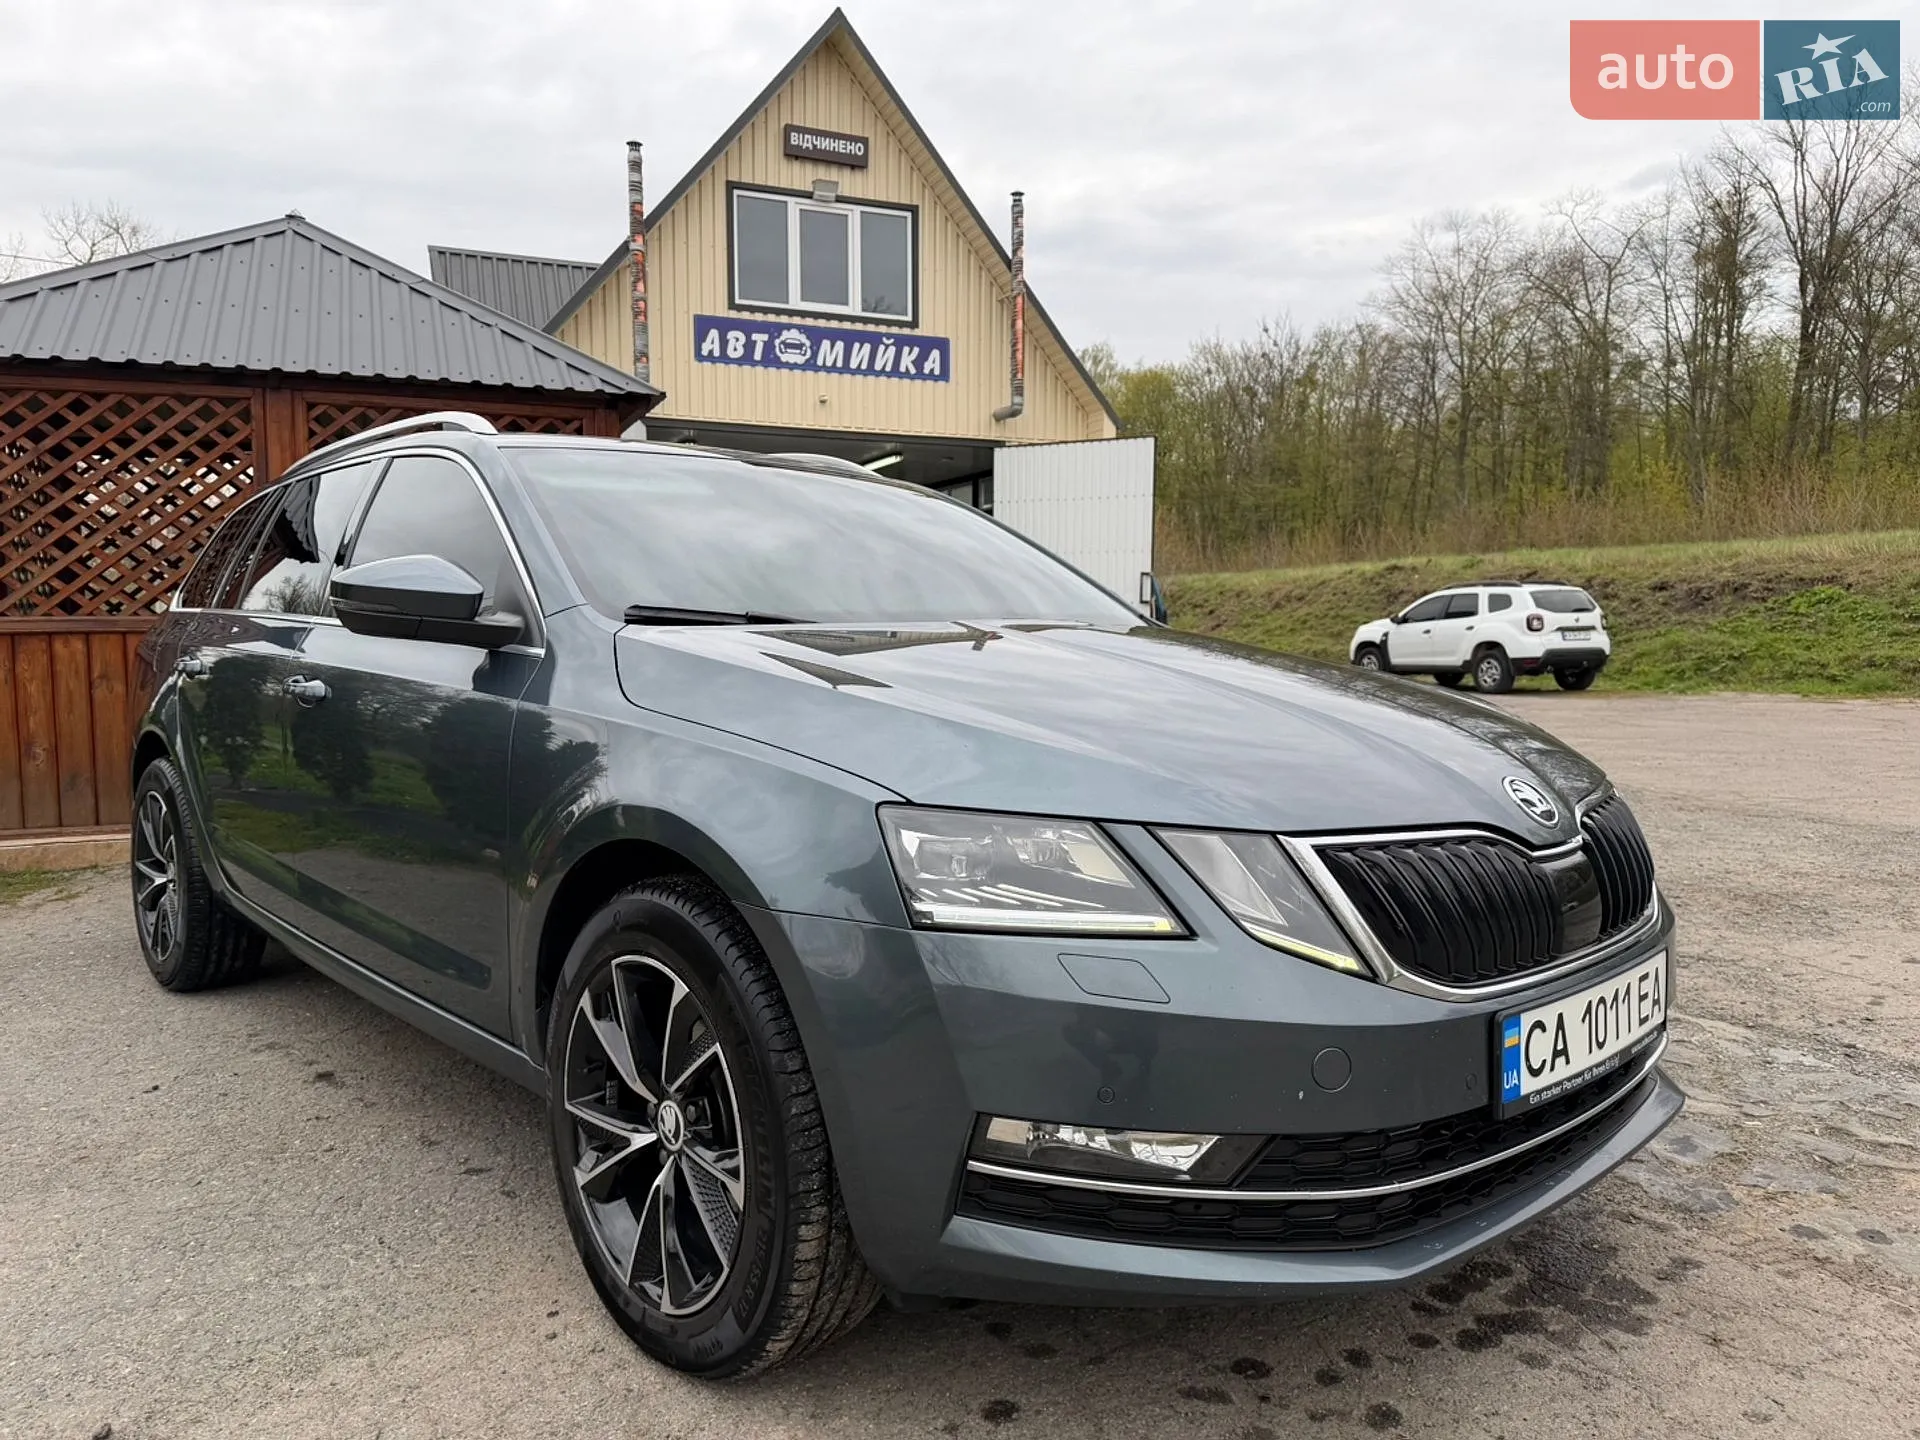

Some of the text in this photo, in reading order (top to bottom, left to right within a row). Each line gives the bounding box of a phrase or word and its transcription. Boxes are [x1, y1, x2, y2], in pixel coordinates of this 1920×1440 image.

[790, 131, 865, 156] ВІДЧИНЕНО
[1525, 966, 1662, 1077] CA 1011 EA
[1503, 1068, 1519, 1089] UA
